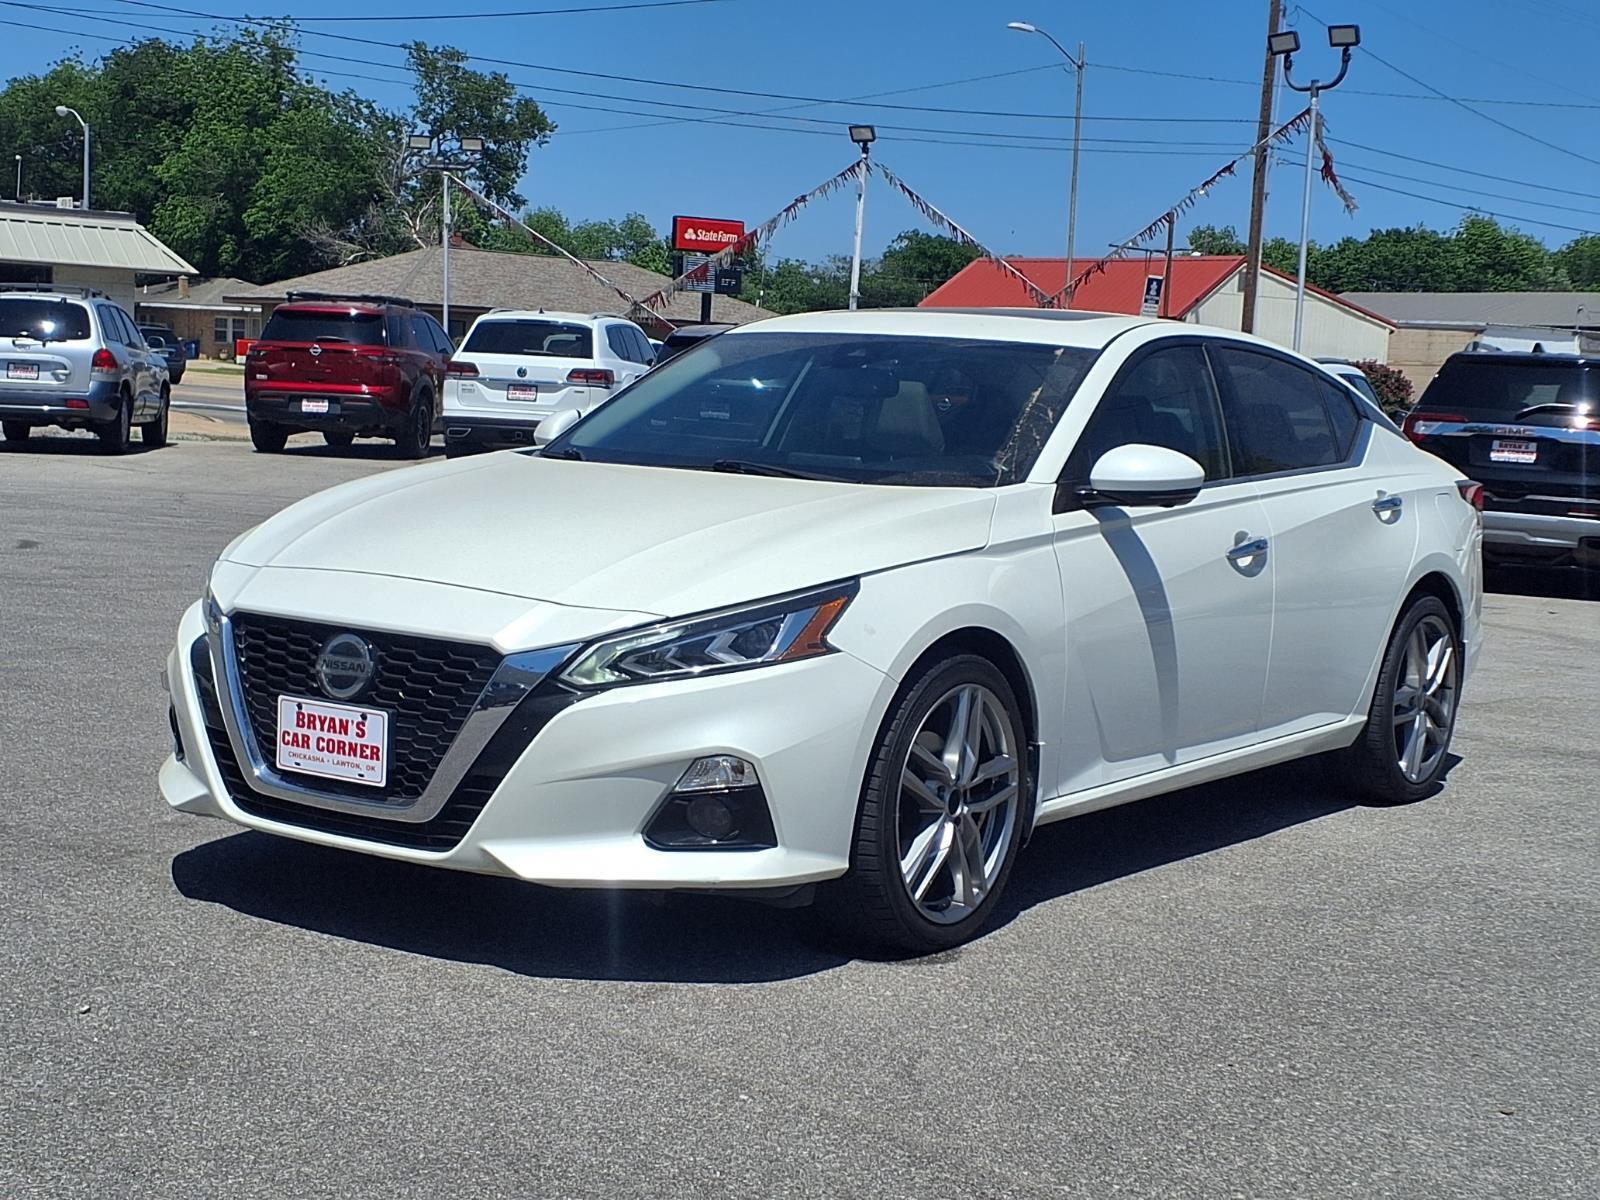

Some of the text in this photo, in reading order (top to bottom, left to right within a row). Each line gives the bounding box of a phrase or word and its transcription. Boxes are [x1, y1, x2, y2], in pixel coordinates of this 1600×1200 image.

[1495, 425, 1536, 437] GMC
[321, 659, 366, 673] NISSAN
[295, 711, 366, 738] BRYAN'S
[282, 730, 381, 762] CAR CORNER
[288, 751, 325, 764] CHICKASHA
[365, 764, 376, 772] OK
